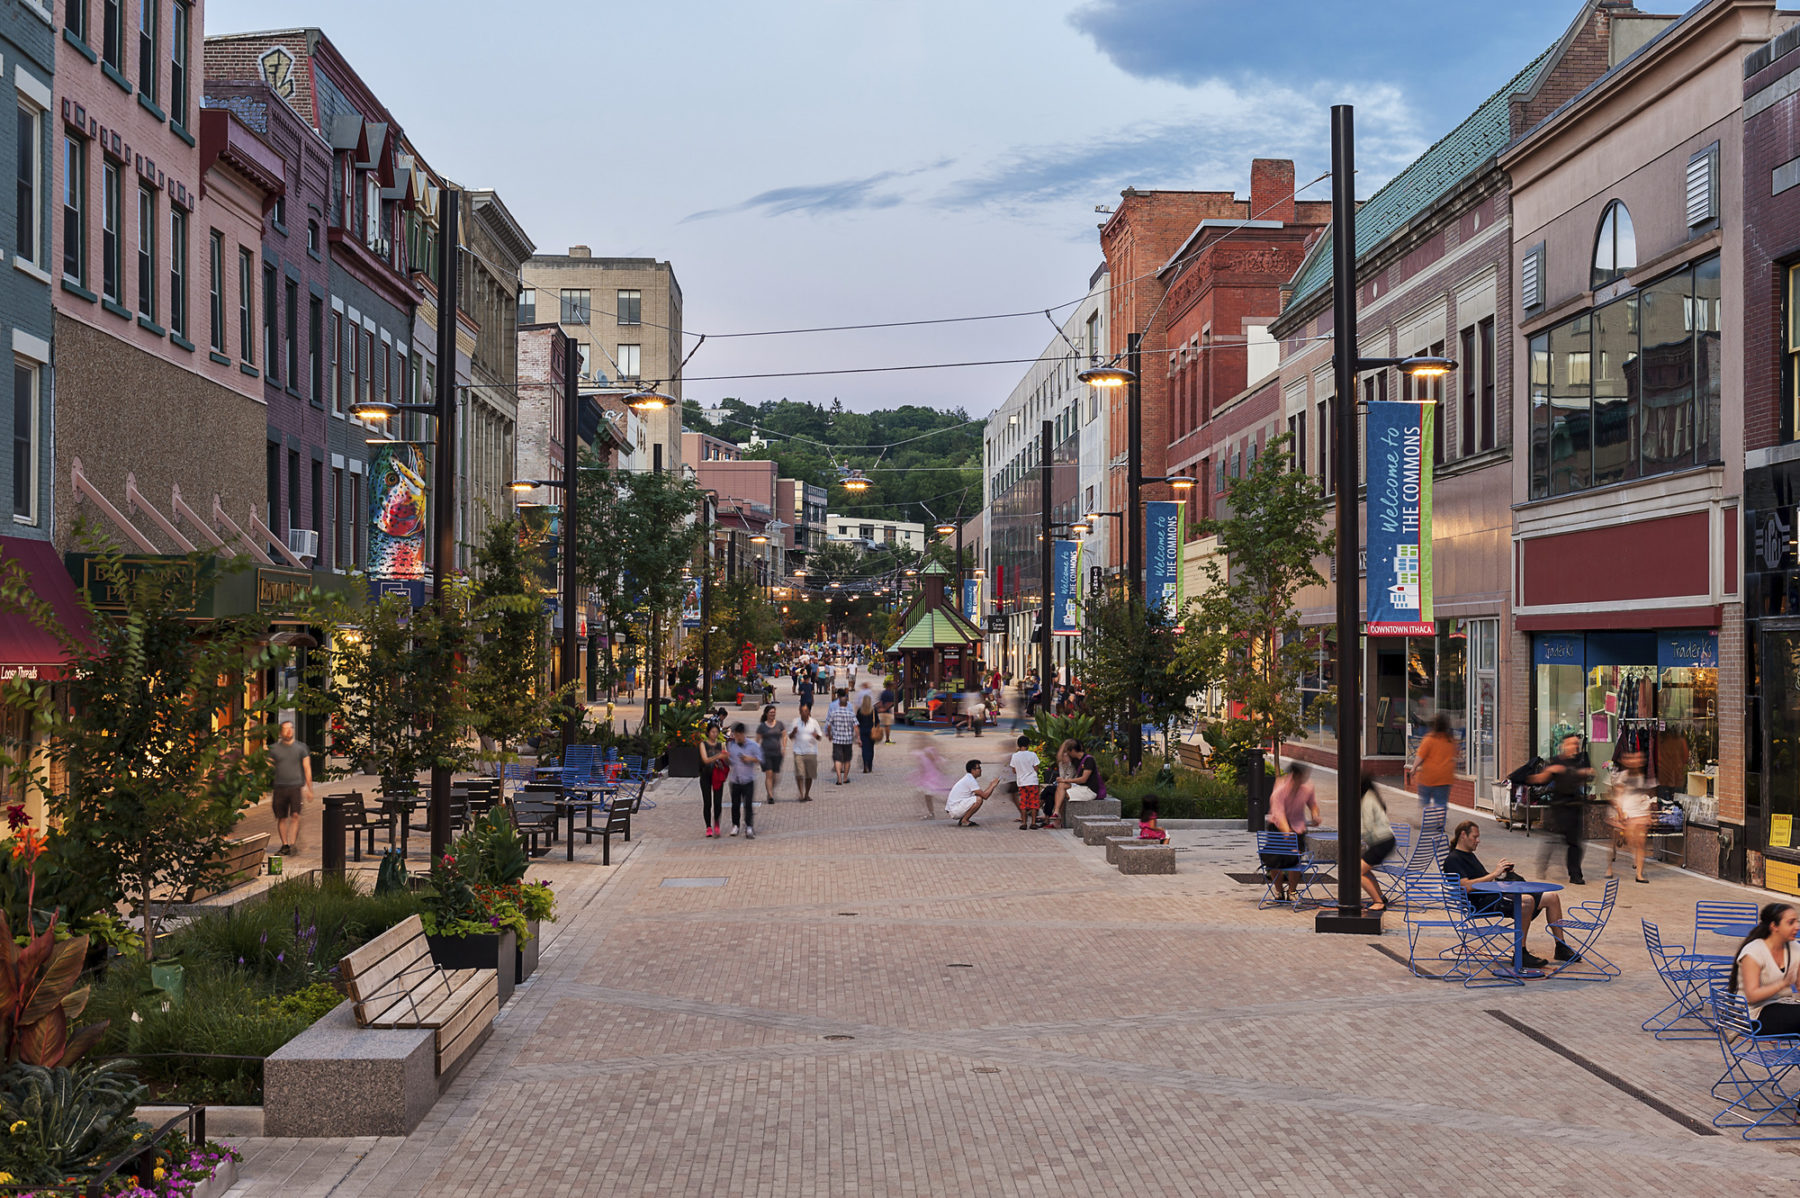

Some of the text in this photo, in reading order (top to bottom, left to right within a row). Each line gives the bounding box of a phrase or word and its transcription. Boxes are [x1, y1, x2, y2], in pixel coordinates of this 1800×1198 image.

[1380, 427, 1399, 532] Welcome to
[1402, 426, 1420, 534] THE COMMONS
[1154, 516, 1166, 577] Welcome to
[1166, 515, 1178, 577] THE COMMONS
[1061, 561, 1070, 595] Welcome
[1069, 551, 1077, 595] THE COMMONS
[1370, 625, 1432, 634] DOWNTOWN ITHACA
[1671, 641, 1700, 658] Trader
[18, 666, 38, 680] Threads
